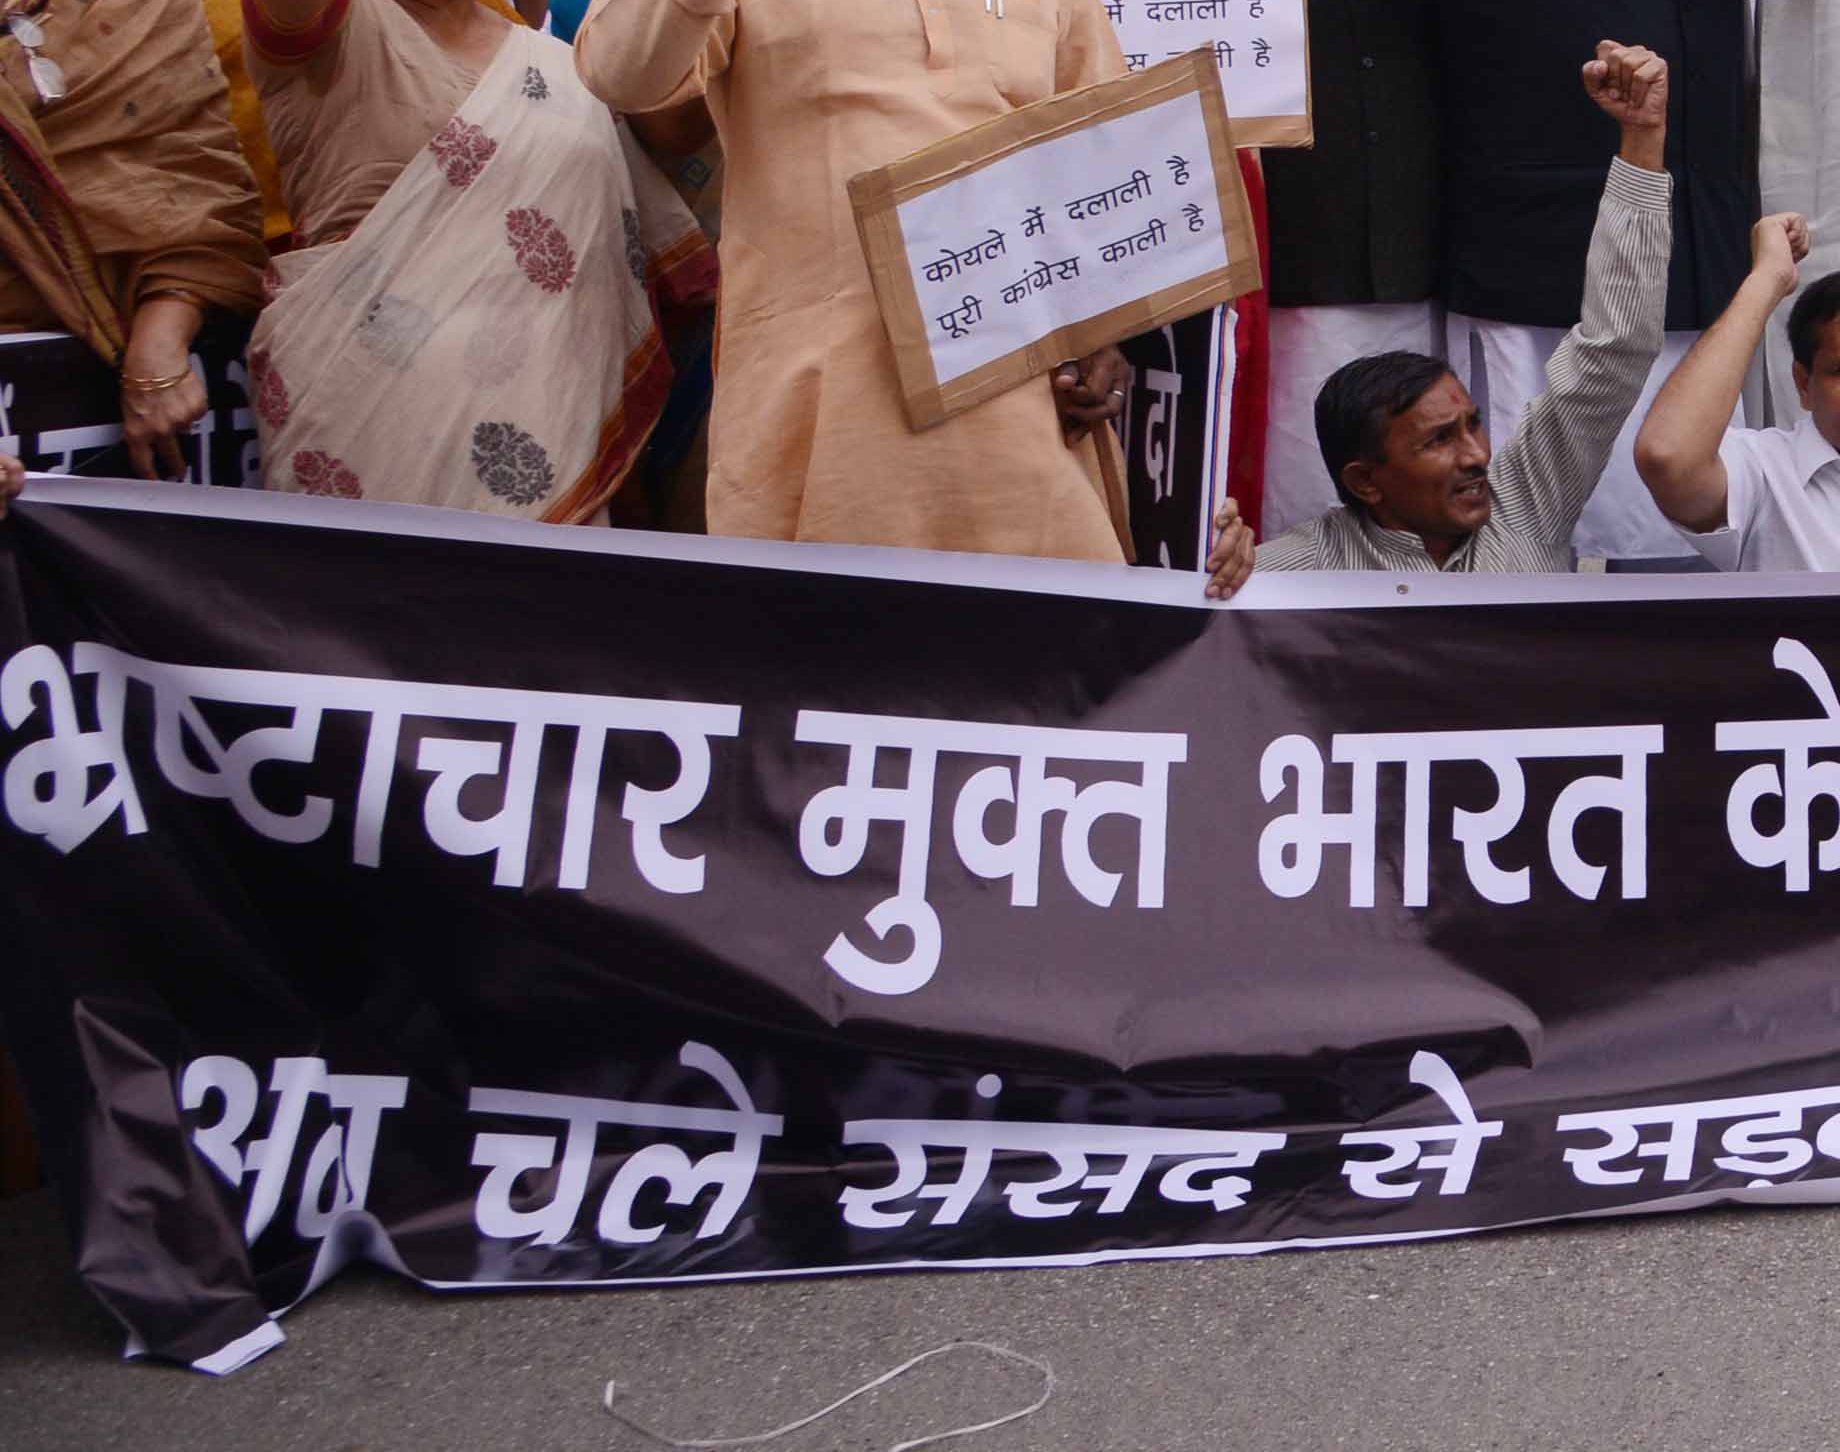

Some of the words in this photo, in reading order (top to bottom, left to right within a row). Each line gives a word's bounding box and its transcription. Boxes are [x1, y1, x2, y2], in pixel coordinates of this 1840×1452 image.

[1251, 38, 1272, 67] है
[922, 229, 1007, 283] कोयले
[1020, 206, 1046, 239] में
[1064, 169, 1151, 221] दलाली
[1165, 155, 1190, 185] है
[936, 294, 983, 339] पूरी
[1000, 255, 1080, 306] कांग्रेस
[1098, 218, 1166, 265] काली
[1182, 203, 1205, 232] है
[0, 640, 742, 895] भ्रष्टाचार
[796, 708, 1187, 995] मुक्त
[1258, 721, 1663, 908] भारत
[468, 1041, 783, 1249] चले
[837, 1073, 1285, 1230] संसद
[1341, 1051, 1504, 1199] से
